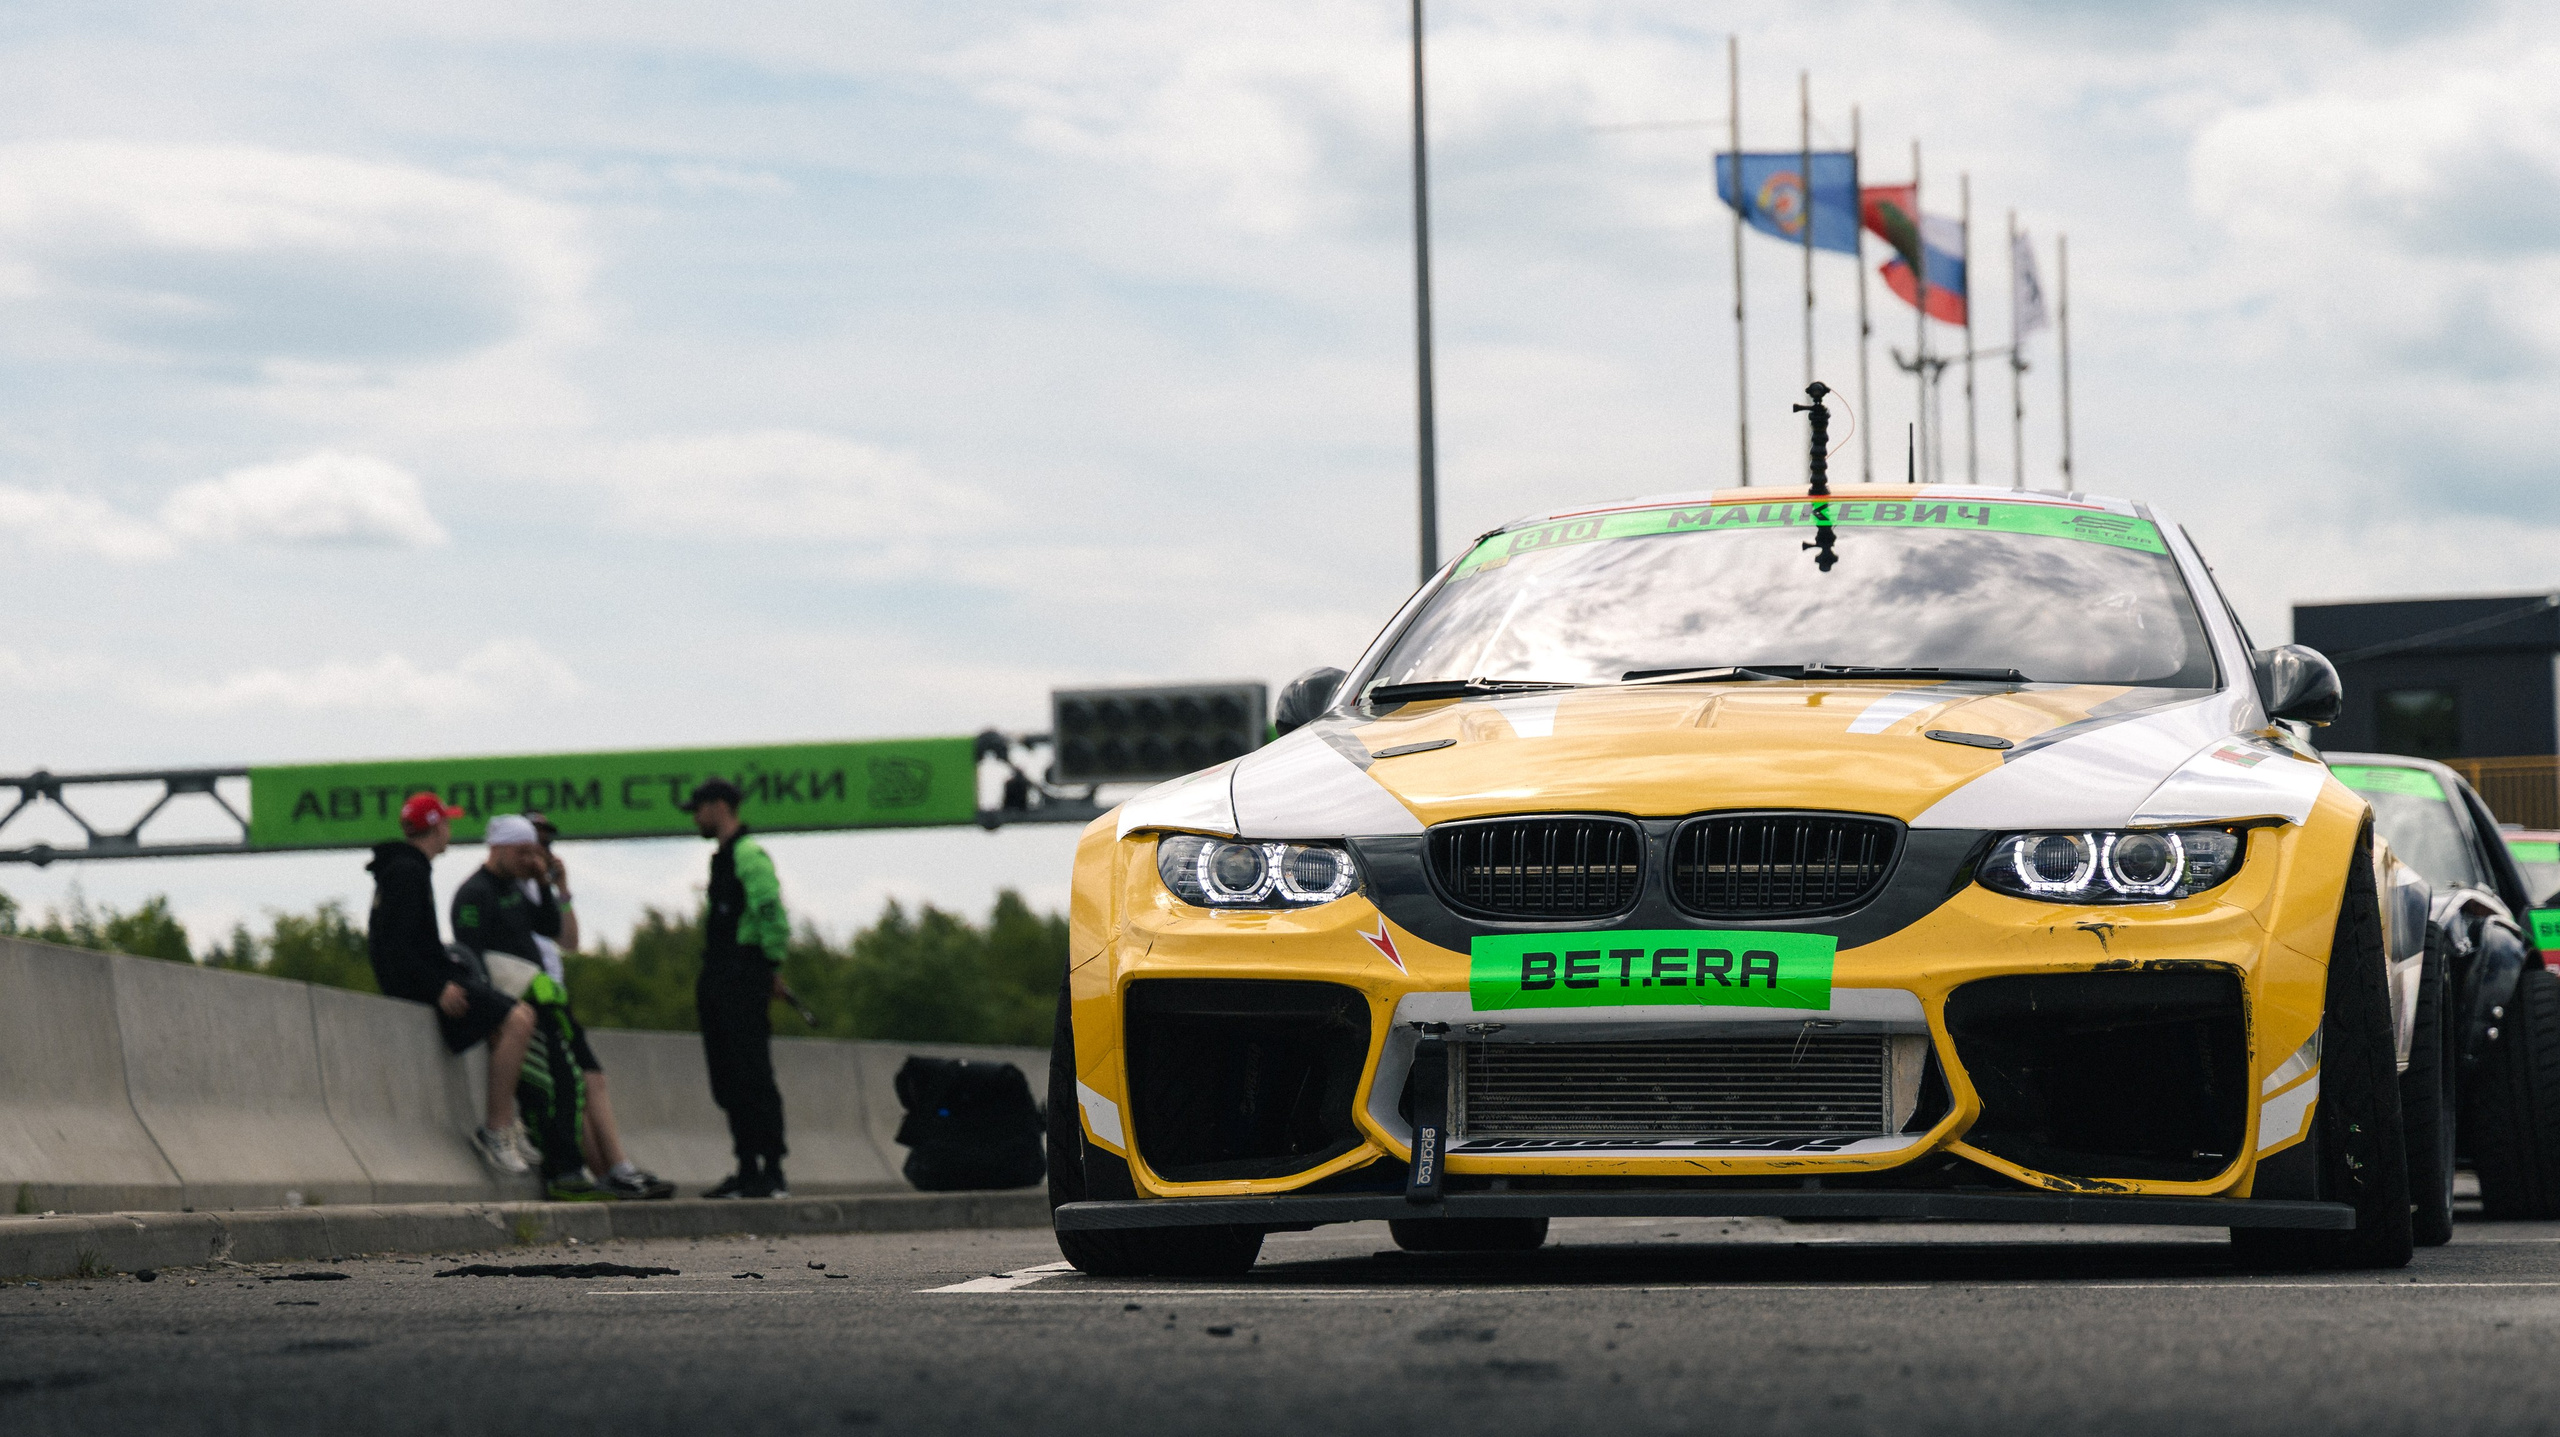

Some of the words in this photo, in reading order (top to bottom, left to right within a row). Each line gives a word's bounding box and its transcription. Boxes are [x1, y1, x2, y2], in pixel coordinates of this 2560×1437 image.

[1667, 502, 1990, 527] МАЦКЕВИЧ
[1515, 519, 1596, 550] 810
[292, 778, 602, 823] АВТДРОМ
[620, 760, 846, 811] СТЙКИ
[1521, 948, 1779, 990] BETERA
